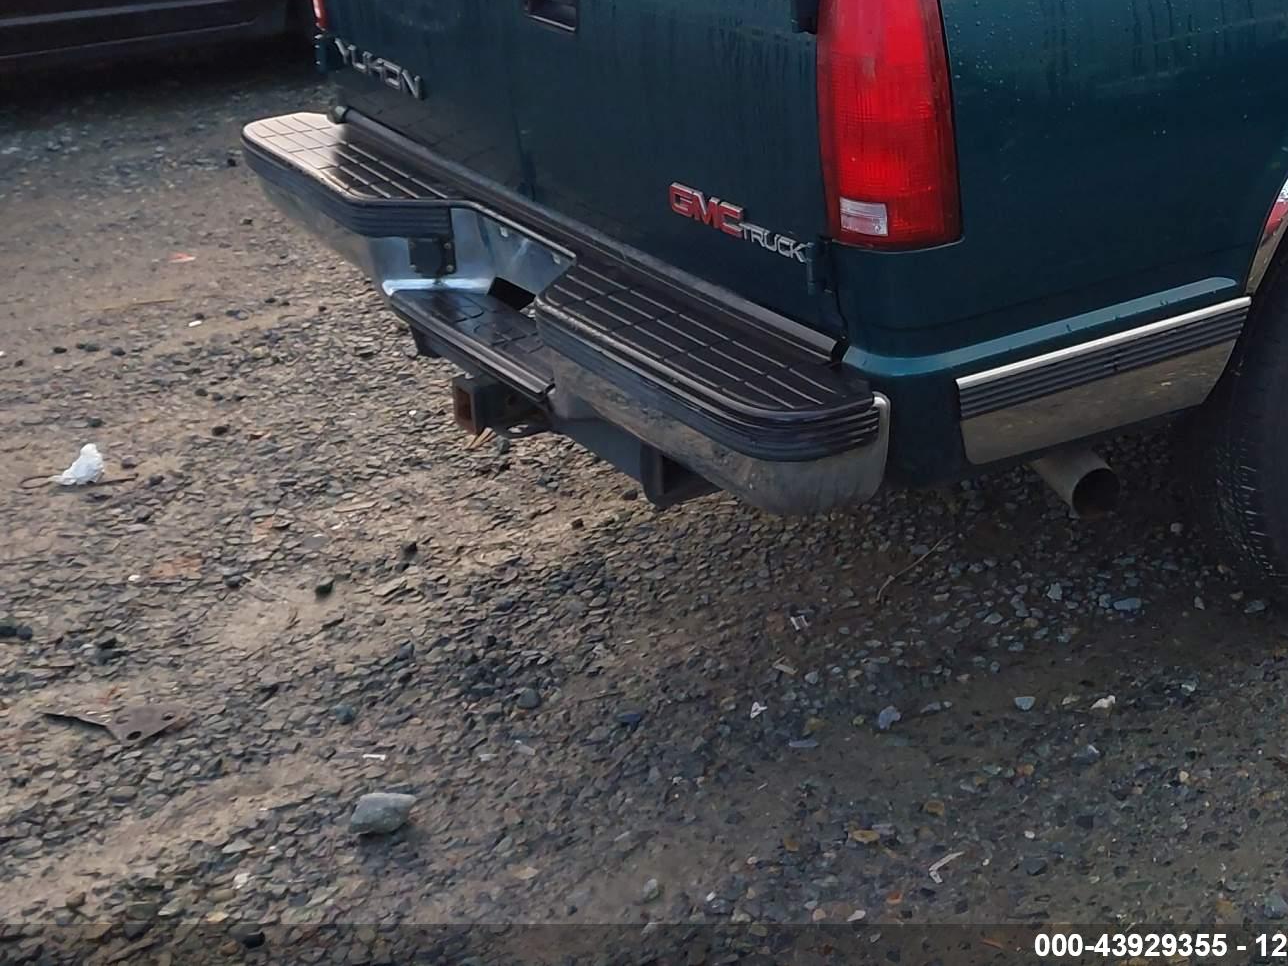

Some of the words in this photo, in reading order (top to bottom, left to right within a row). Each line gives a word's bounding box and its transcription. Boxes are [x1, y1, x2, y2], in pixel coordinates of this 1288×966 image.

[334, 37, 421, 98] YUKON
[669, 182, 743, 239] GMC
[739, 222, 815, 264] TRUCK
